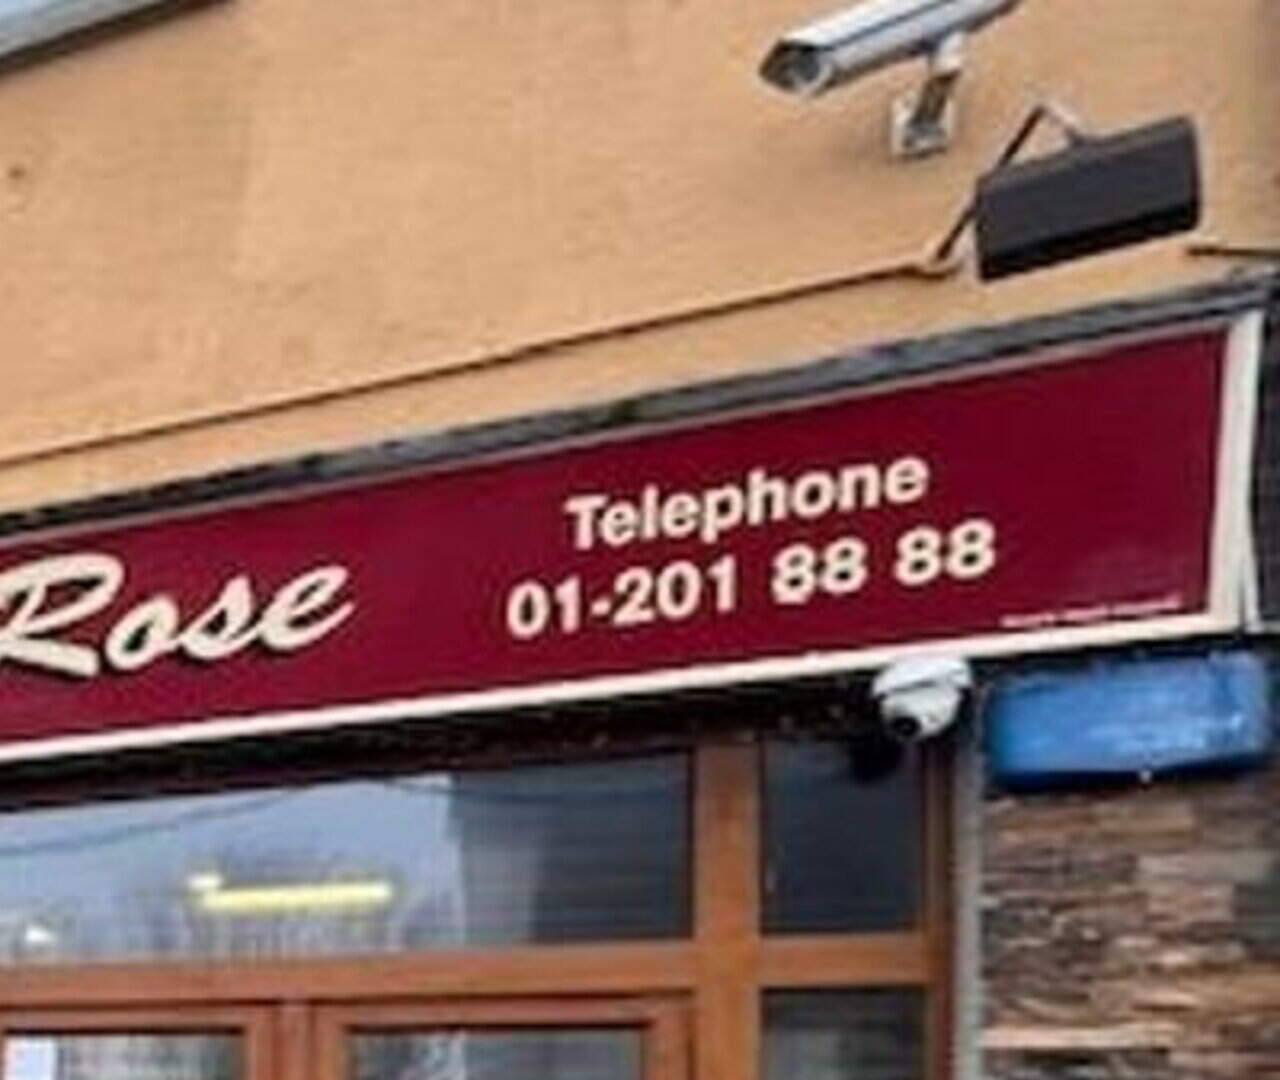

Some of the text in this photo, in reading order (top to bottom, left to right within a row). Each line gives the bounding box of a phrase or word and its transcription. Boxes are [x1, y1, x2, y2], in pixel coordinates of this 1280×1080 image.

[564, 456, 931, 551] Telephone
[506, 518, 997, 639] 01-201 88 88
